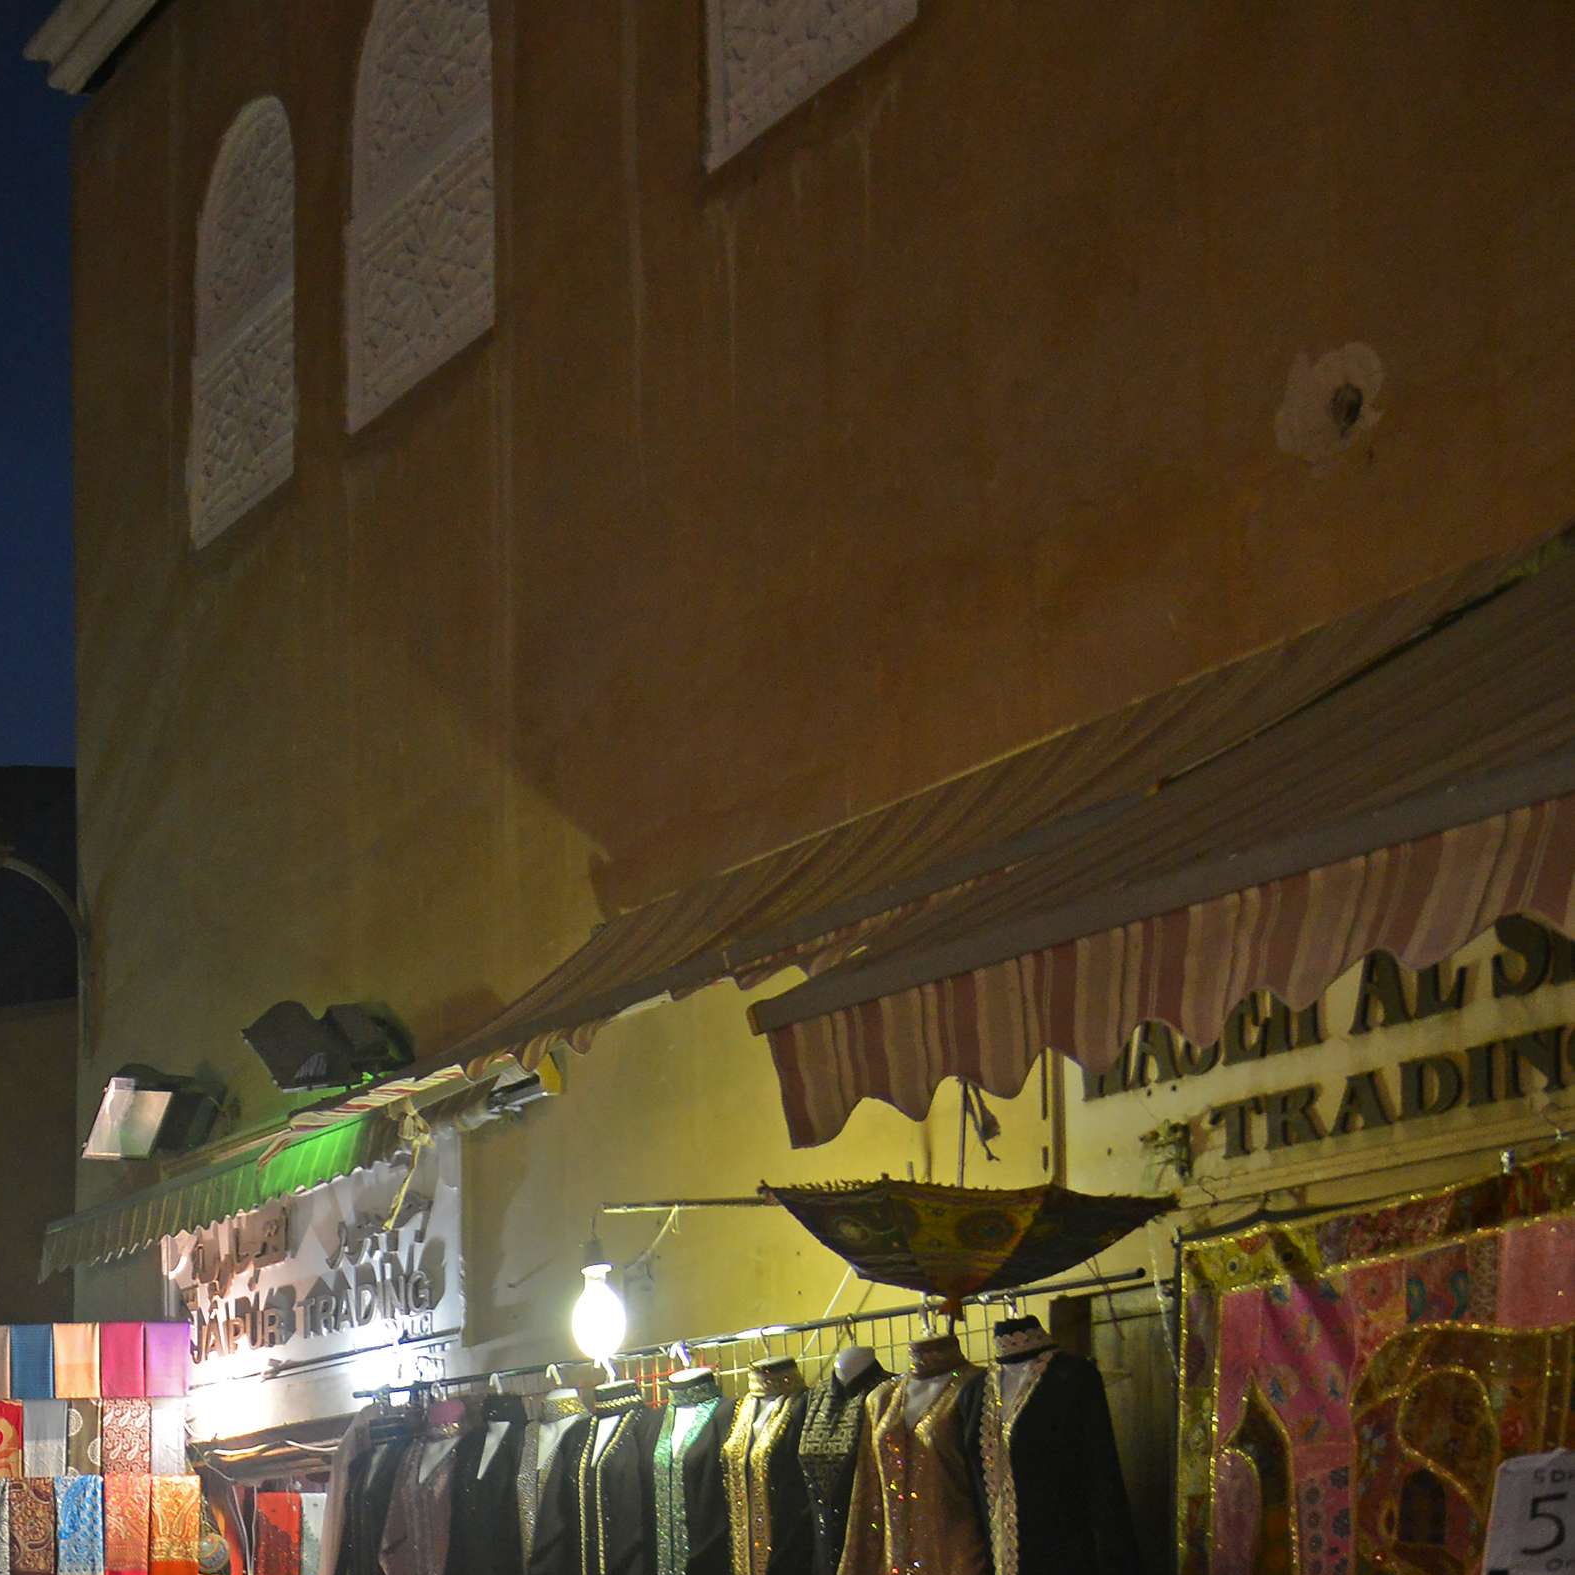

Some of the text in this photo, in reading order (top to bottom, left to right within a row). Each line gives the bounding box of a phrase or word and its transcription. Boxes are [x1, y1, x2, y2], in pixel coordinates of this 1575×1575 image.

[1492, 913, 1575, 998] S
[1210, 1022, 1575, 1159] TRADIN
[295, 1270, 432, 1338] TRADING
